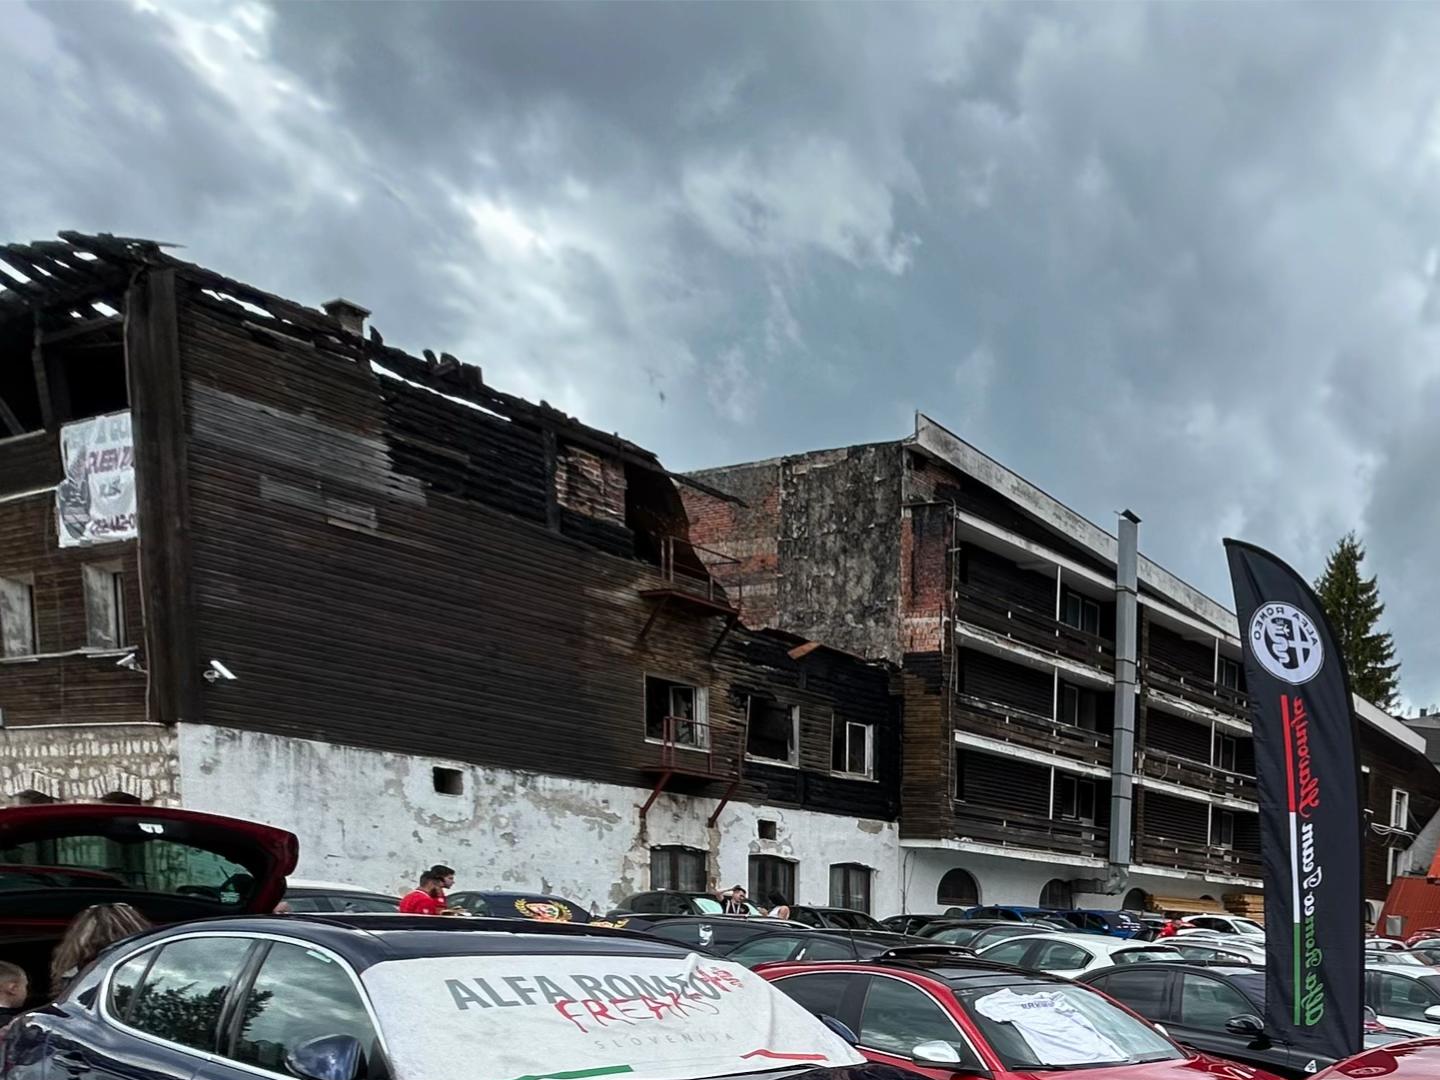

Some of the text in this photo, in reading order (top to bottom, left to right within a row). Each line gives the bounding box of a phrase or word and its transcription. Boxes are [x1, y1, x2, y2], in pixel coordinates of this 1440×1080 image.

[444, 974, 580, 1011] ALFA
[569, 970, 721, 1001] ROMEO
[554, 991, 720, 1034] FREAKS
[594, 1032, 735, 1050] SLOVENIJA
